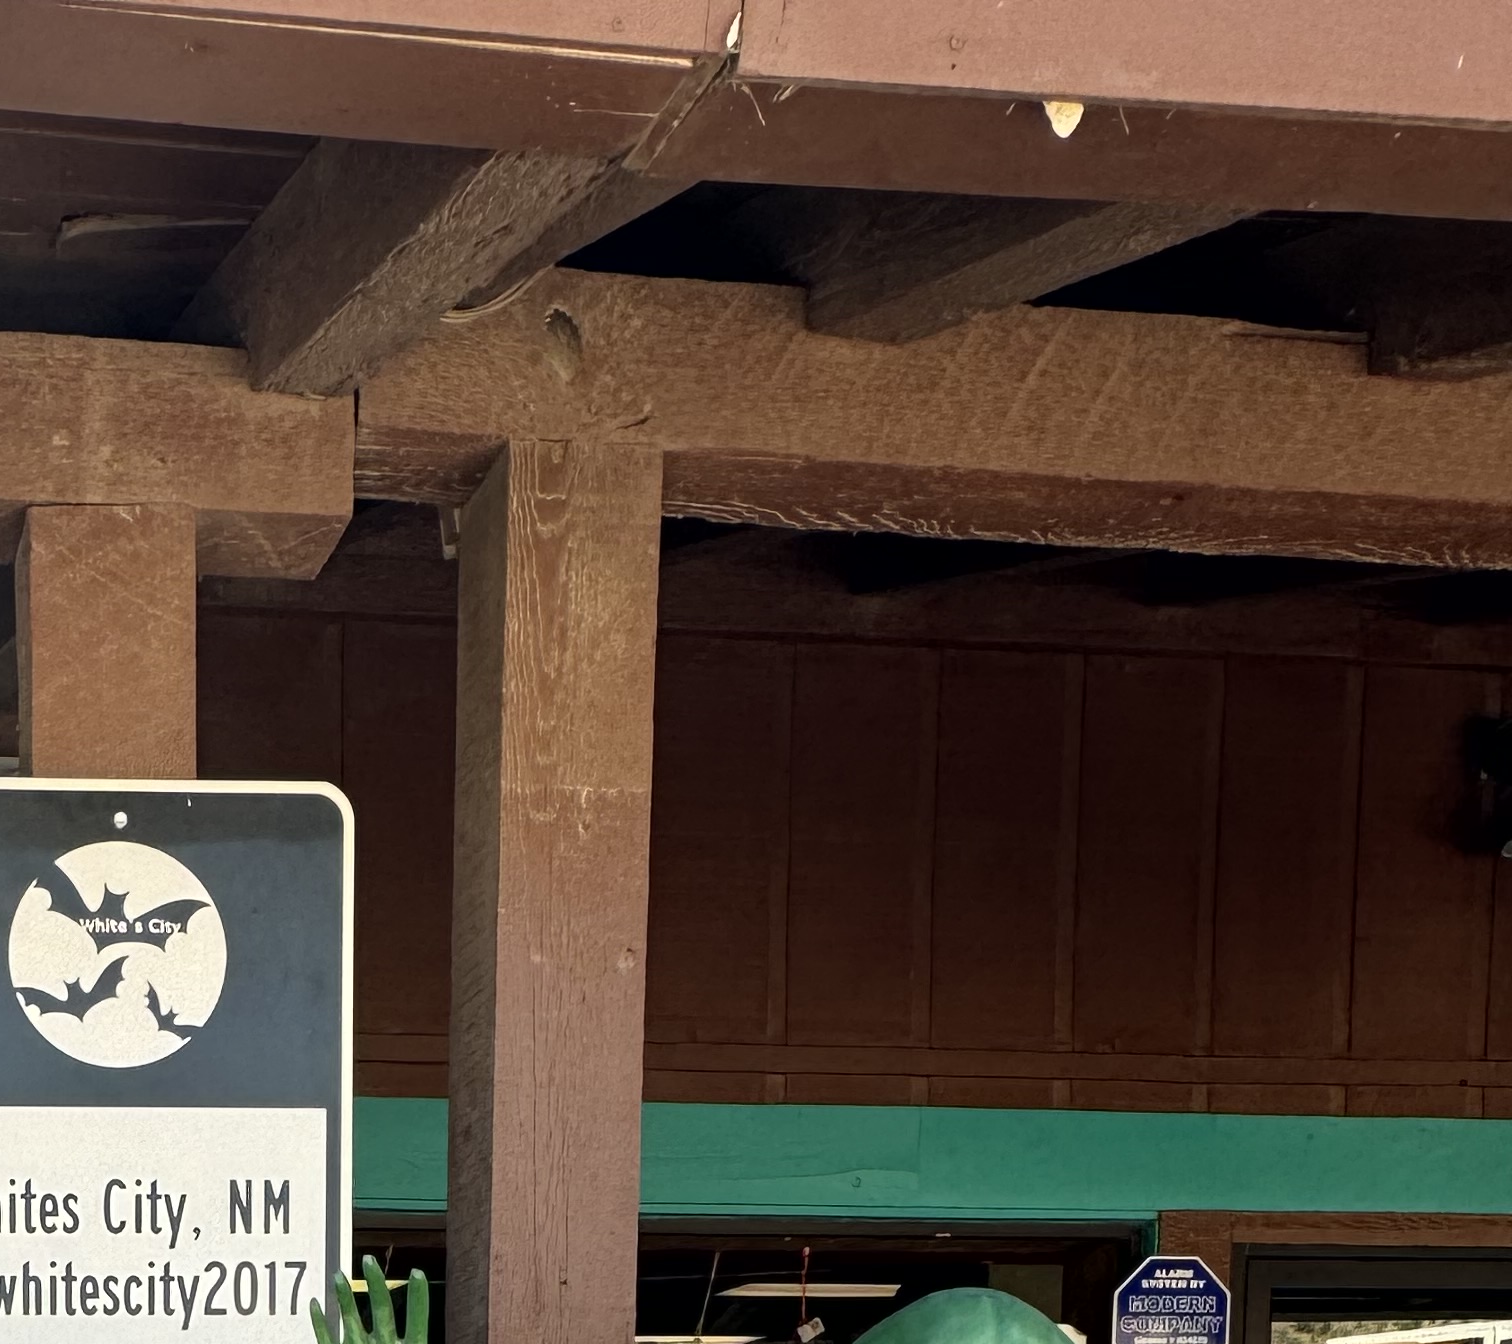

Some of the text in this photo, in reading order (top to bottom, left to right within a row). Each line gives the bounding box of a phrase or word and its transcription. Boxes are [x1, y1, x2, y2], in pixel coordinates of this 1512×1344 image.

[78, 917, 182, 936] White's City
[103, 1178, 202, 1250] City,
[229, 1179, 291, 1234] NM
[1128, 1295, 1217, 1314] MODERN
[1119, 1315, 1225, 1335] COMPANY
